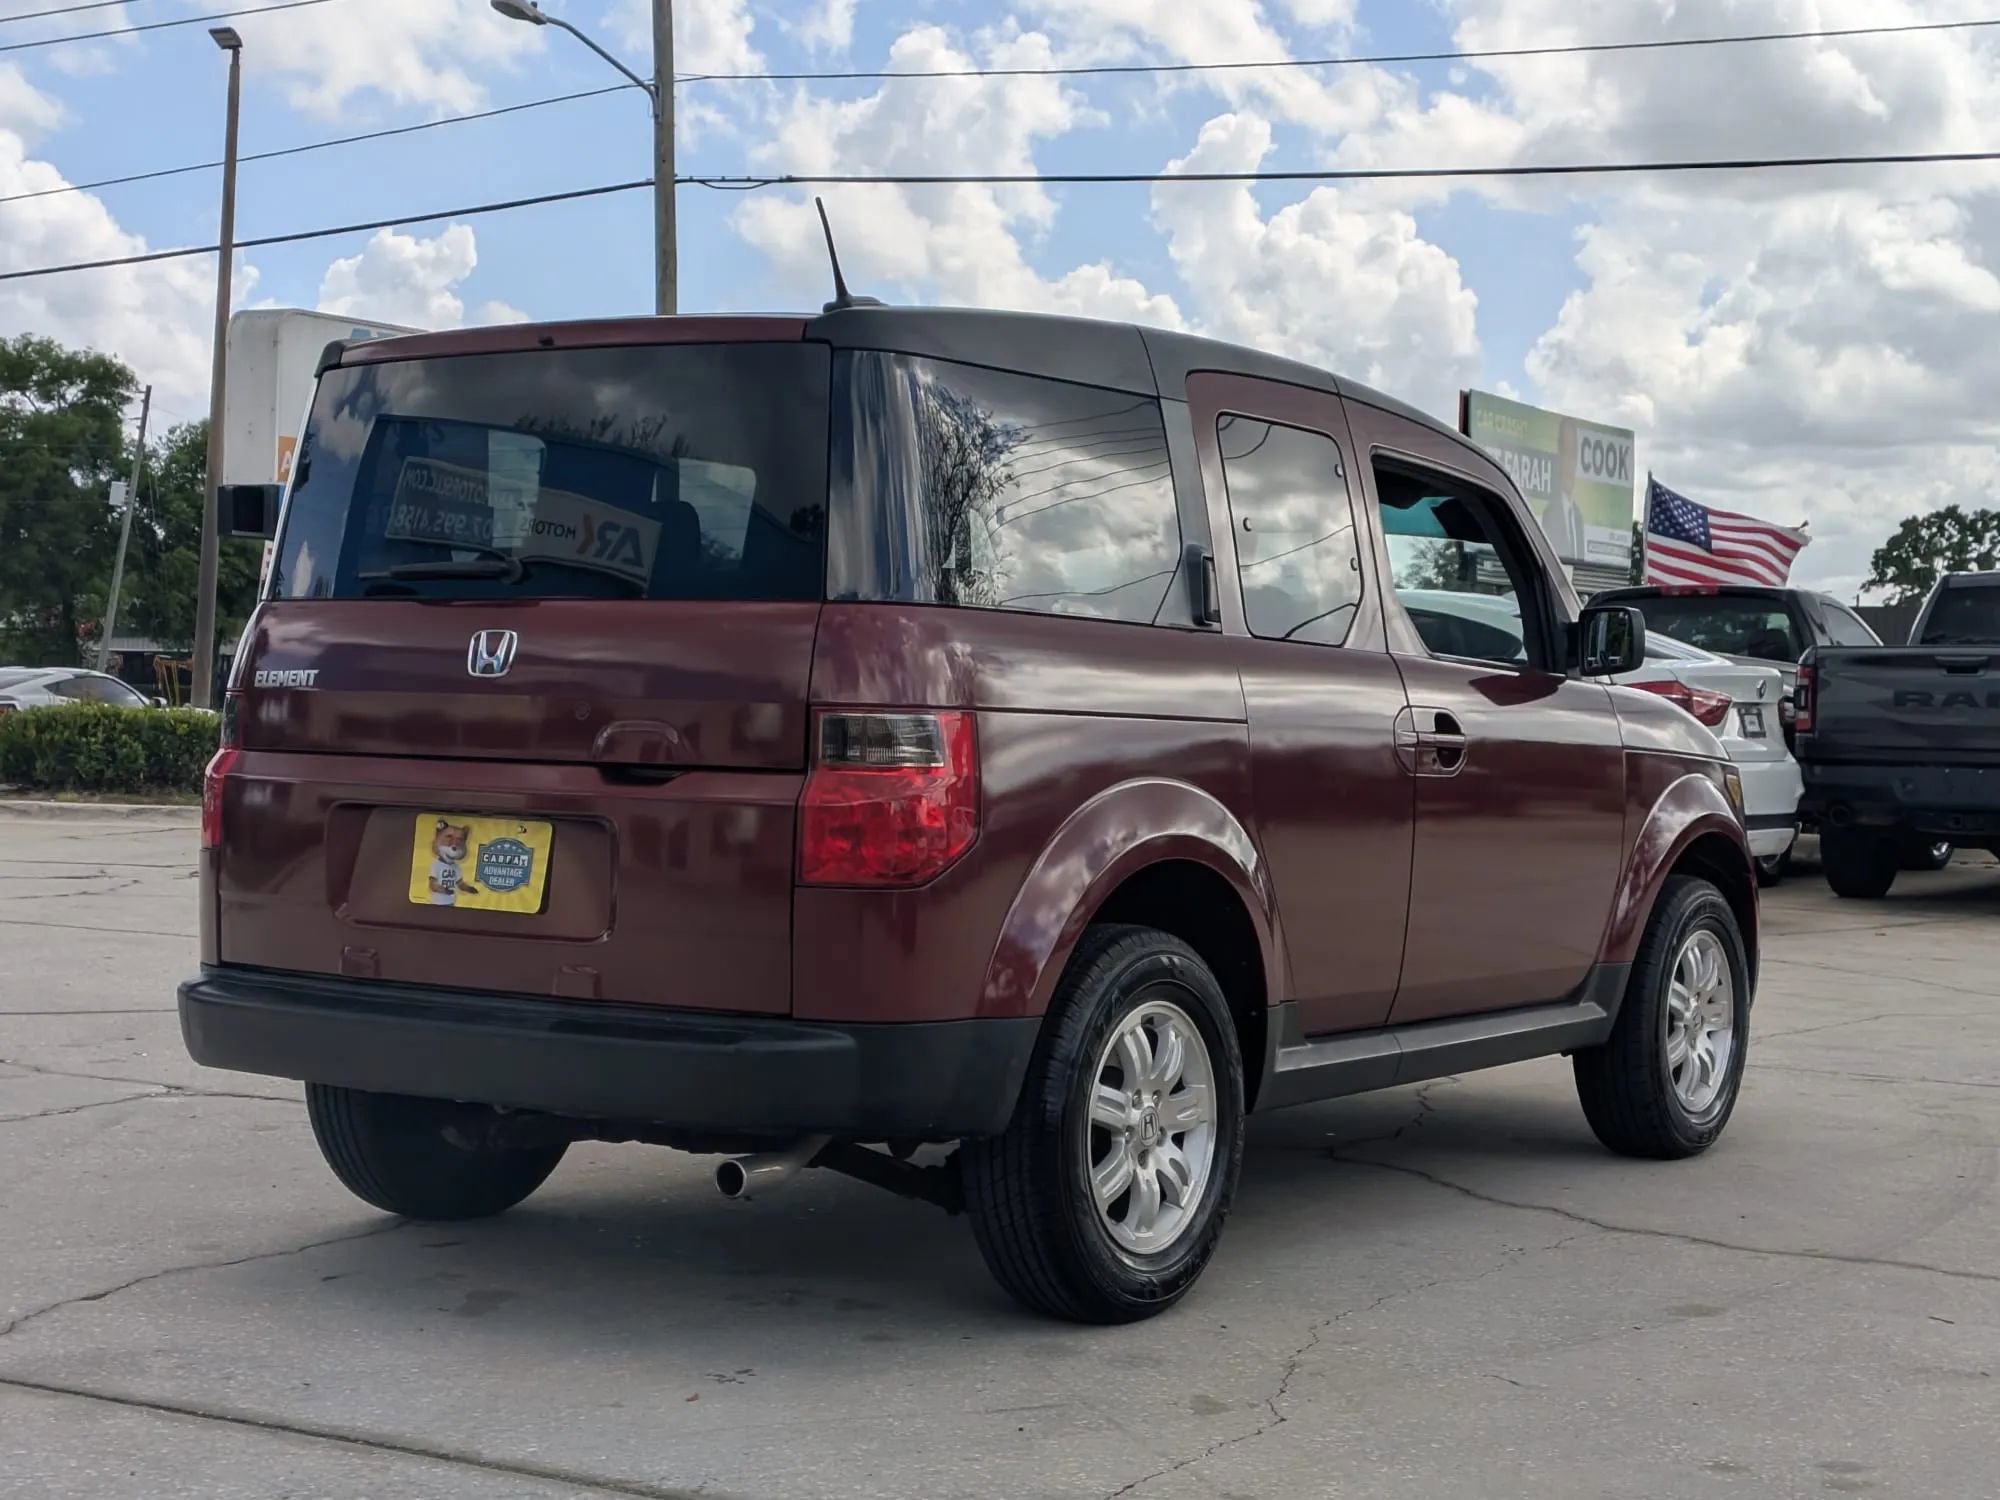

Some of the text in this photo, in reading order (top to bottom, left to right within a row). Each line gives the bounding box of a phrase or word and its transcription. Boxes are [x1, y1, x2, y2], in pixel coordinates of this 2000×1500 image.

[1580, 437, 1631, 481] COOK
[254, 669, 319, 687] ELEMENT
[483, 853, 528, 867] CARFAX
[483, 865, 523, 878] ADVANTAGE
[489, 875, 515, 887] DEALER
